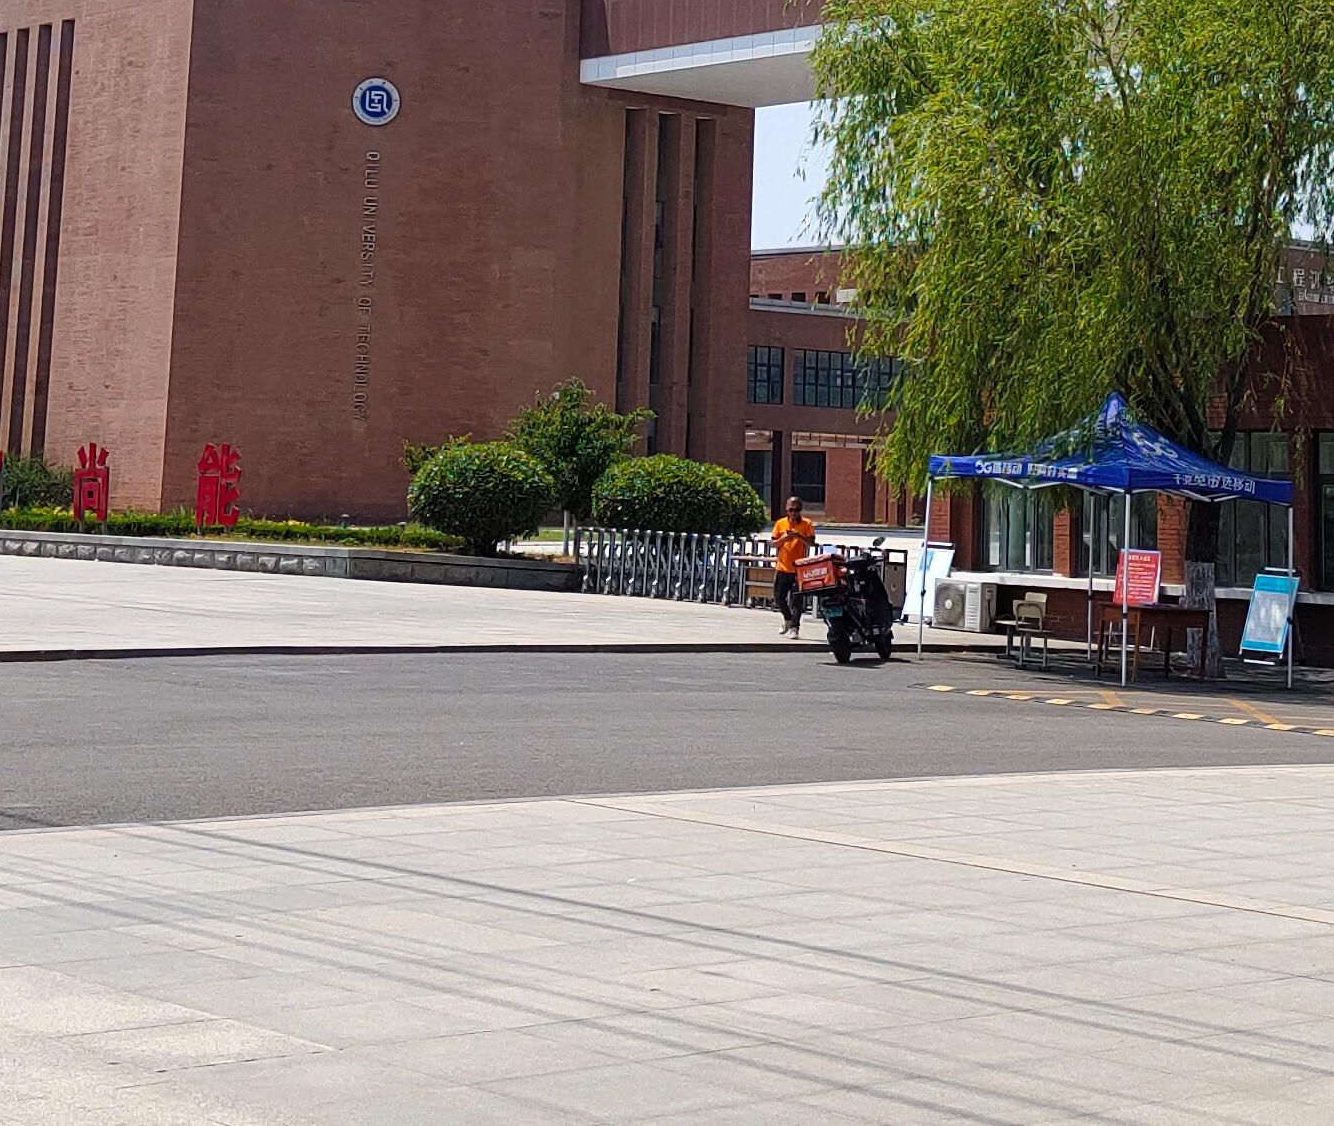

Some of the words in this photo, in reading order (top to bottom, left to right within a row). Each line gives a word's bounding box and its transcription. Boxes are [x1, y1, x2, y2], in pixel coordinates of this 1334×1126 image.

[364, 151, 380, 189] QILU
[359, 196, 379, 288] UNIVERSITY
[357, 297, 372, 316] OF
[352, 323, 371, 421] TECHNOLOGY
